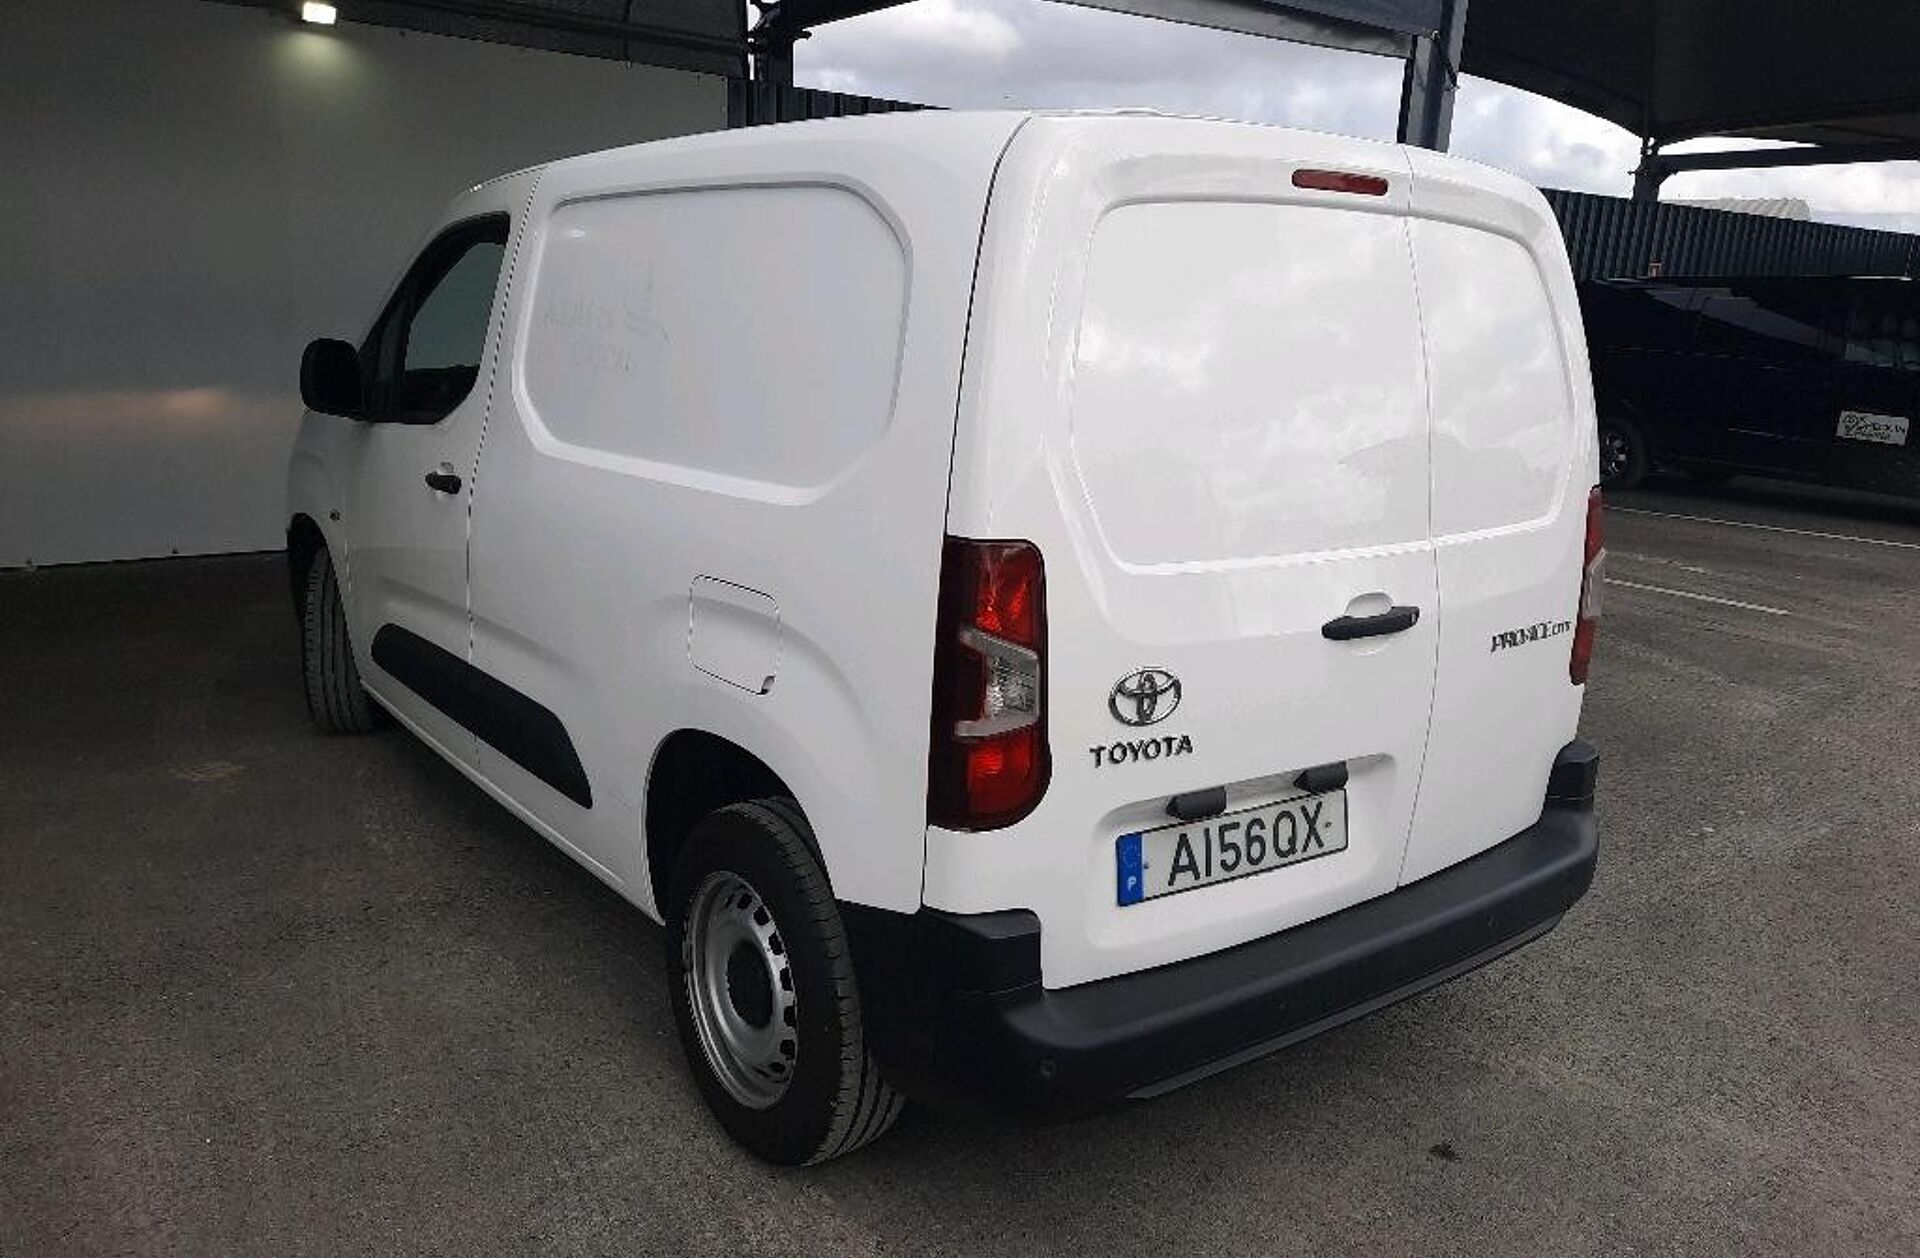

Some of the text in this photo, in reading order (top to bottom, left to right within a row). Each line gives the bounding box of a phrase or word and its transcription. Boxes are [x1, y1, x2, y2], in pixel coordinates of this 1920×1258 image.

[1089, 734, 1194, 768] TOYOTA
[1167, 800, 1325, 886] AI56QX
[1127, 875, 1138, 892] P
